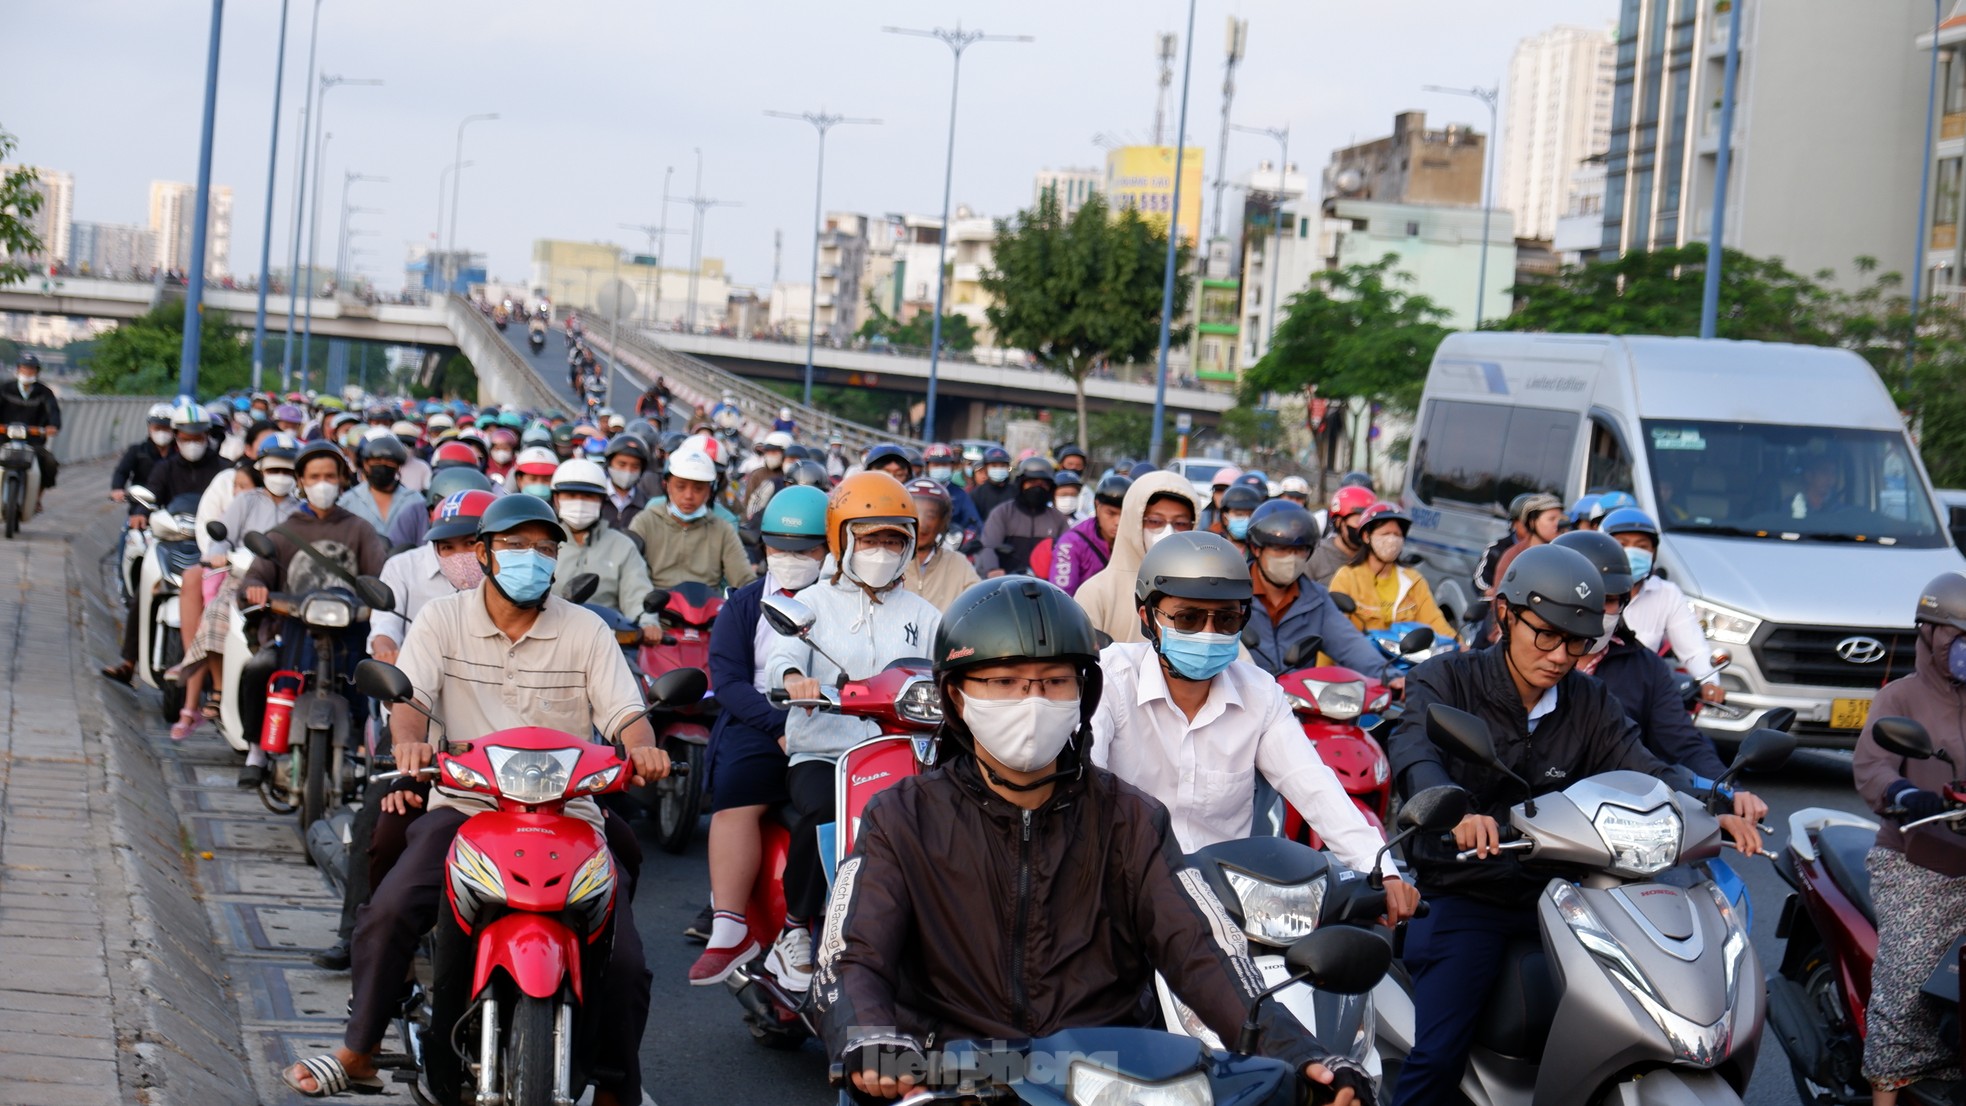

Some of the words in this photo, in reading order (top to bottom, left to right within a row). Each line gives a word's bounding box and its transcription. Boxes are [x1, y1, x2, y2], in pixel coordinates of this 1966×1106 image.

[904, 622, 919, 648] NY
[852, 771, 891, 786] Vespa
[516, 827, 556, 835] HONDA
[836, 861, 858, 900] Stretch
[1640, 889, 1678, 897] HONDA
